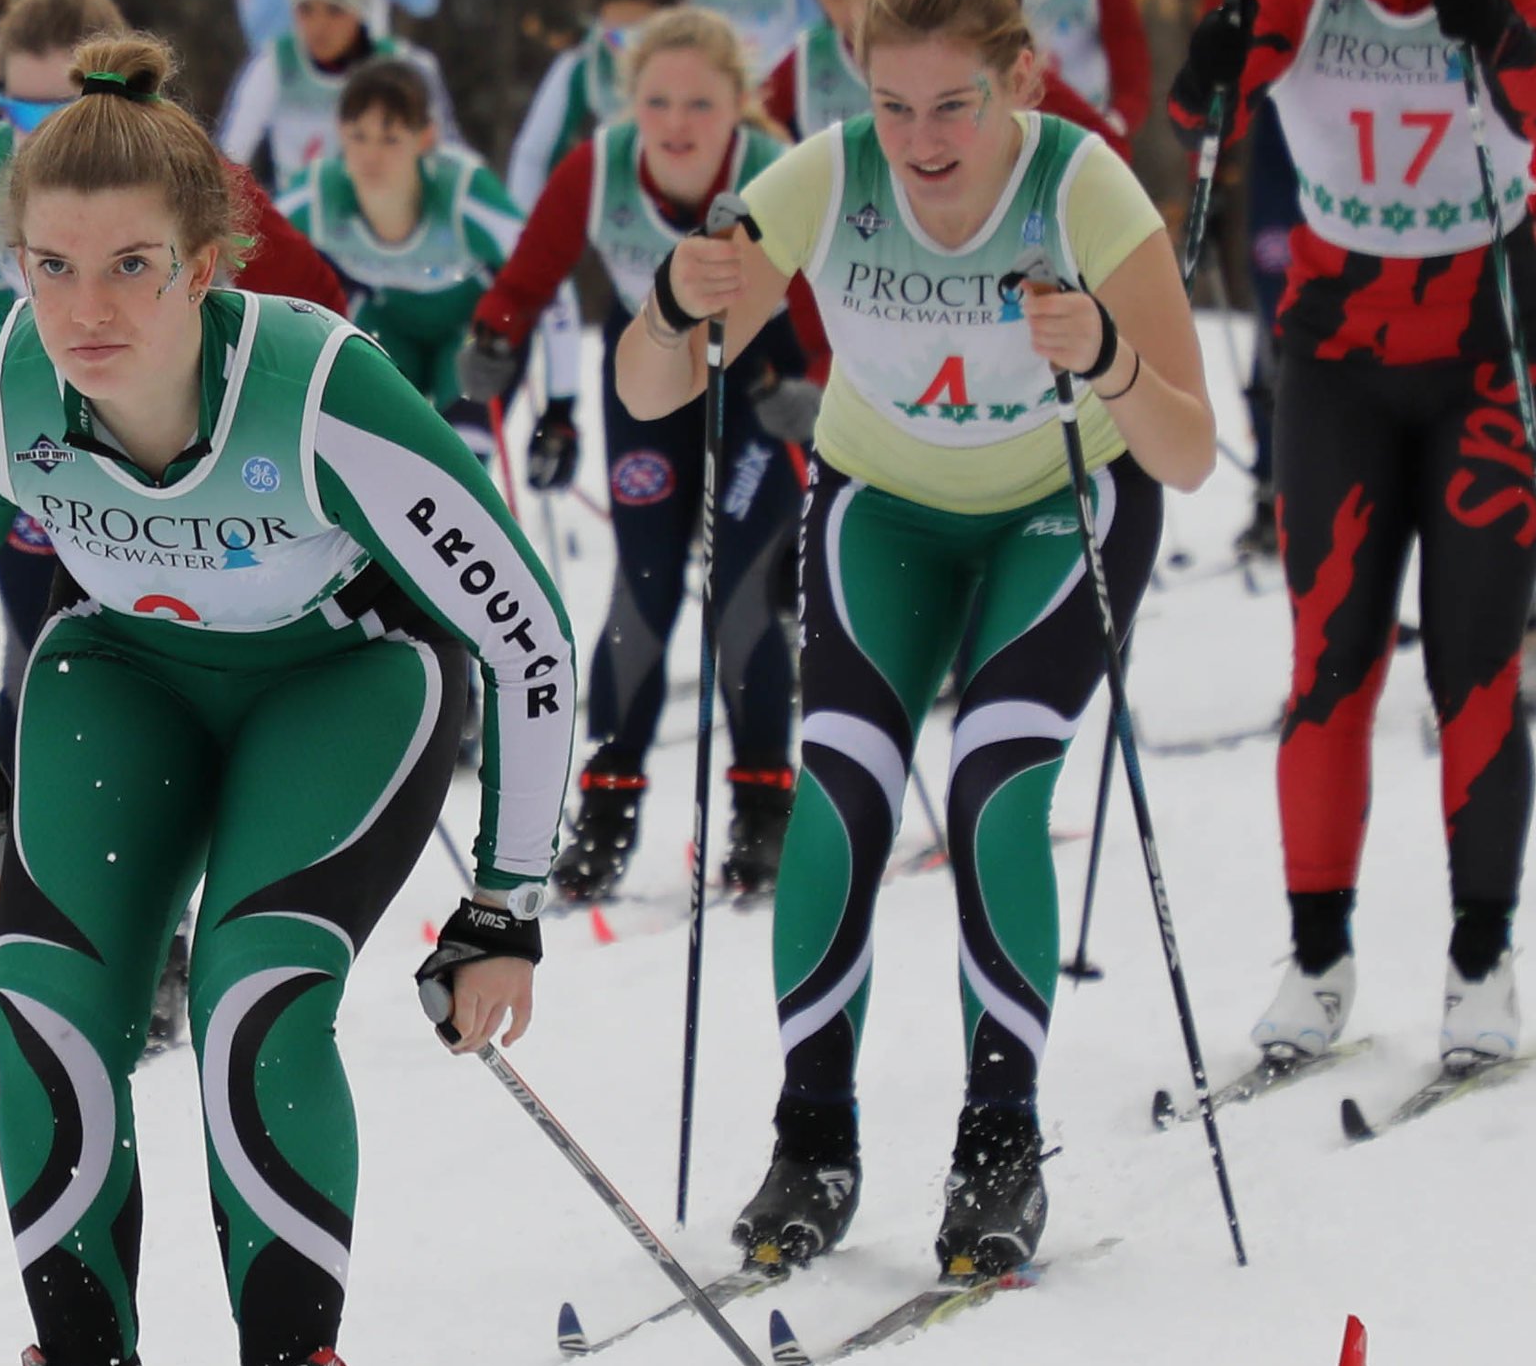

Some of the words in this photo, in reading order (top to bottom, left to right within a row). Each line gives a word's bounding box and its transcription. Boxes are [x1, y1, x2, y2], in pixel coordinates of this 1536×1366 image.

[1349, 109, 1453, 187] 17
[845, 262, 1024, 307] PROCTO
[842, 296, 994, 325] BLACKWATER
[38, 495, 298, 550] PROCTOR
